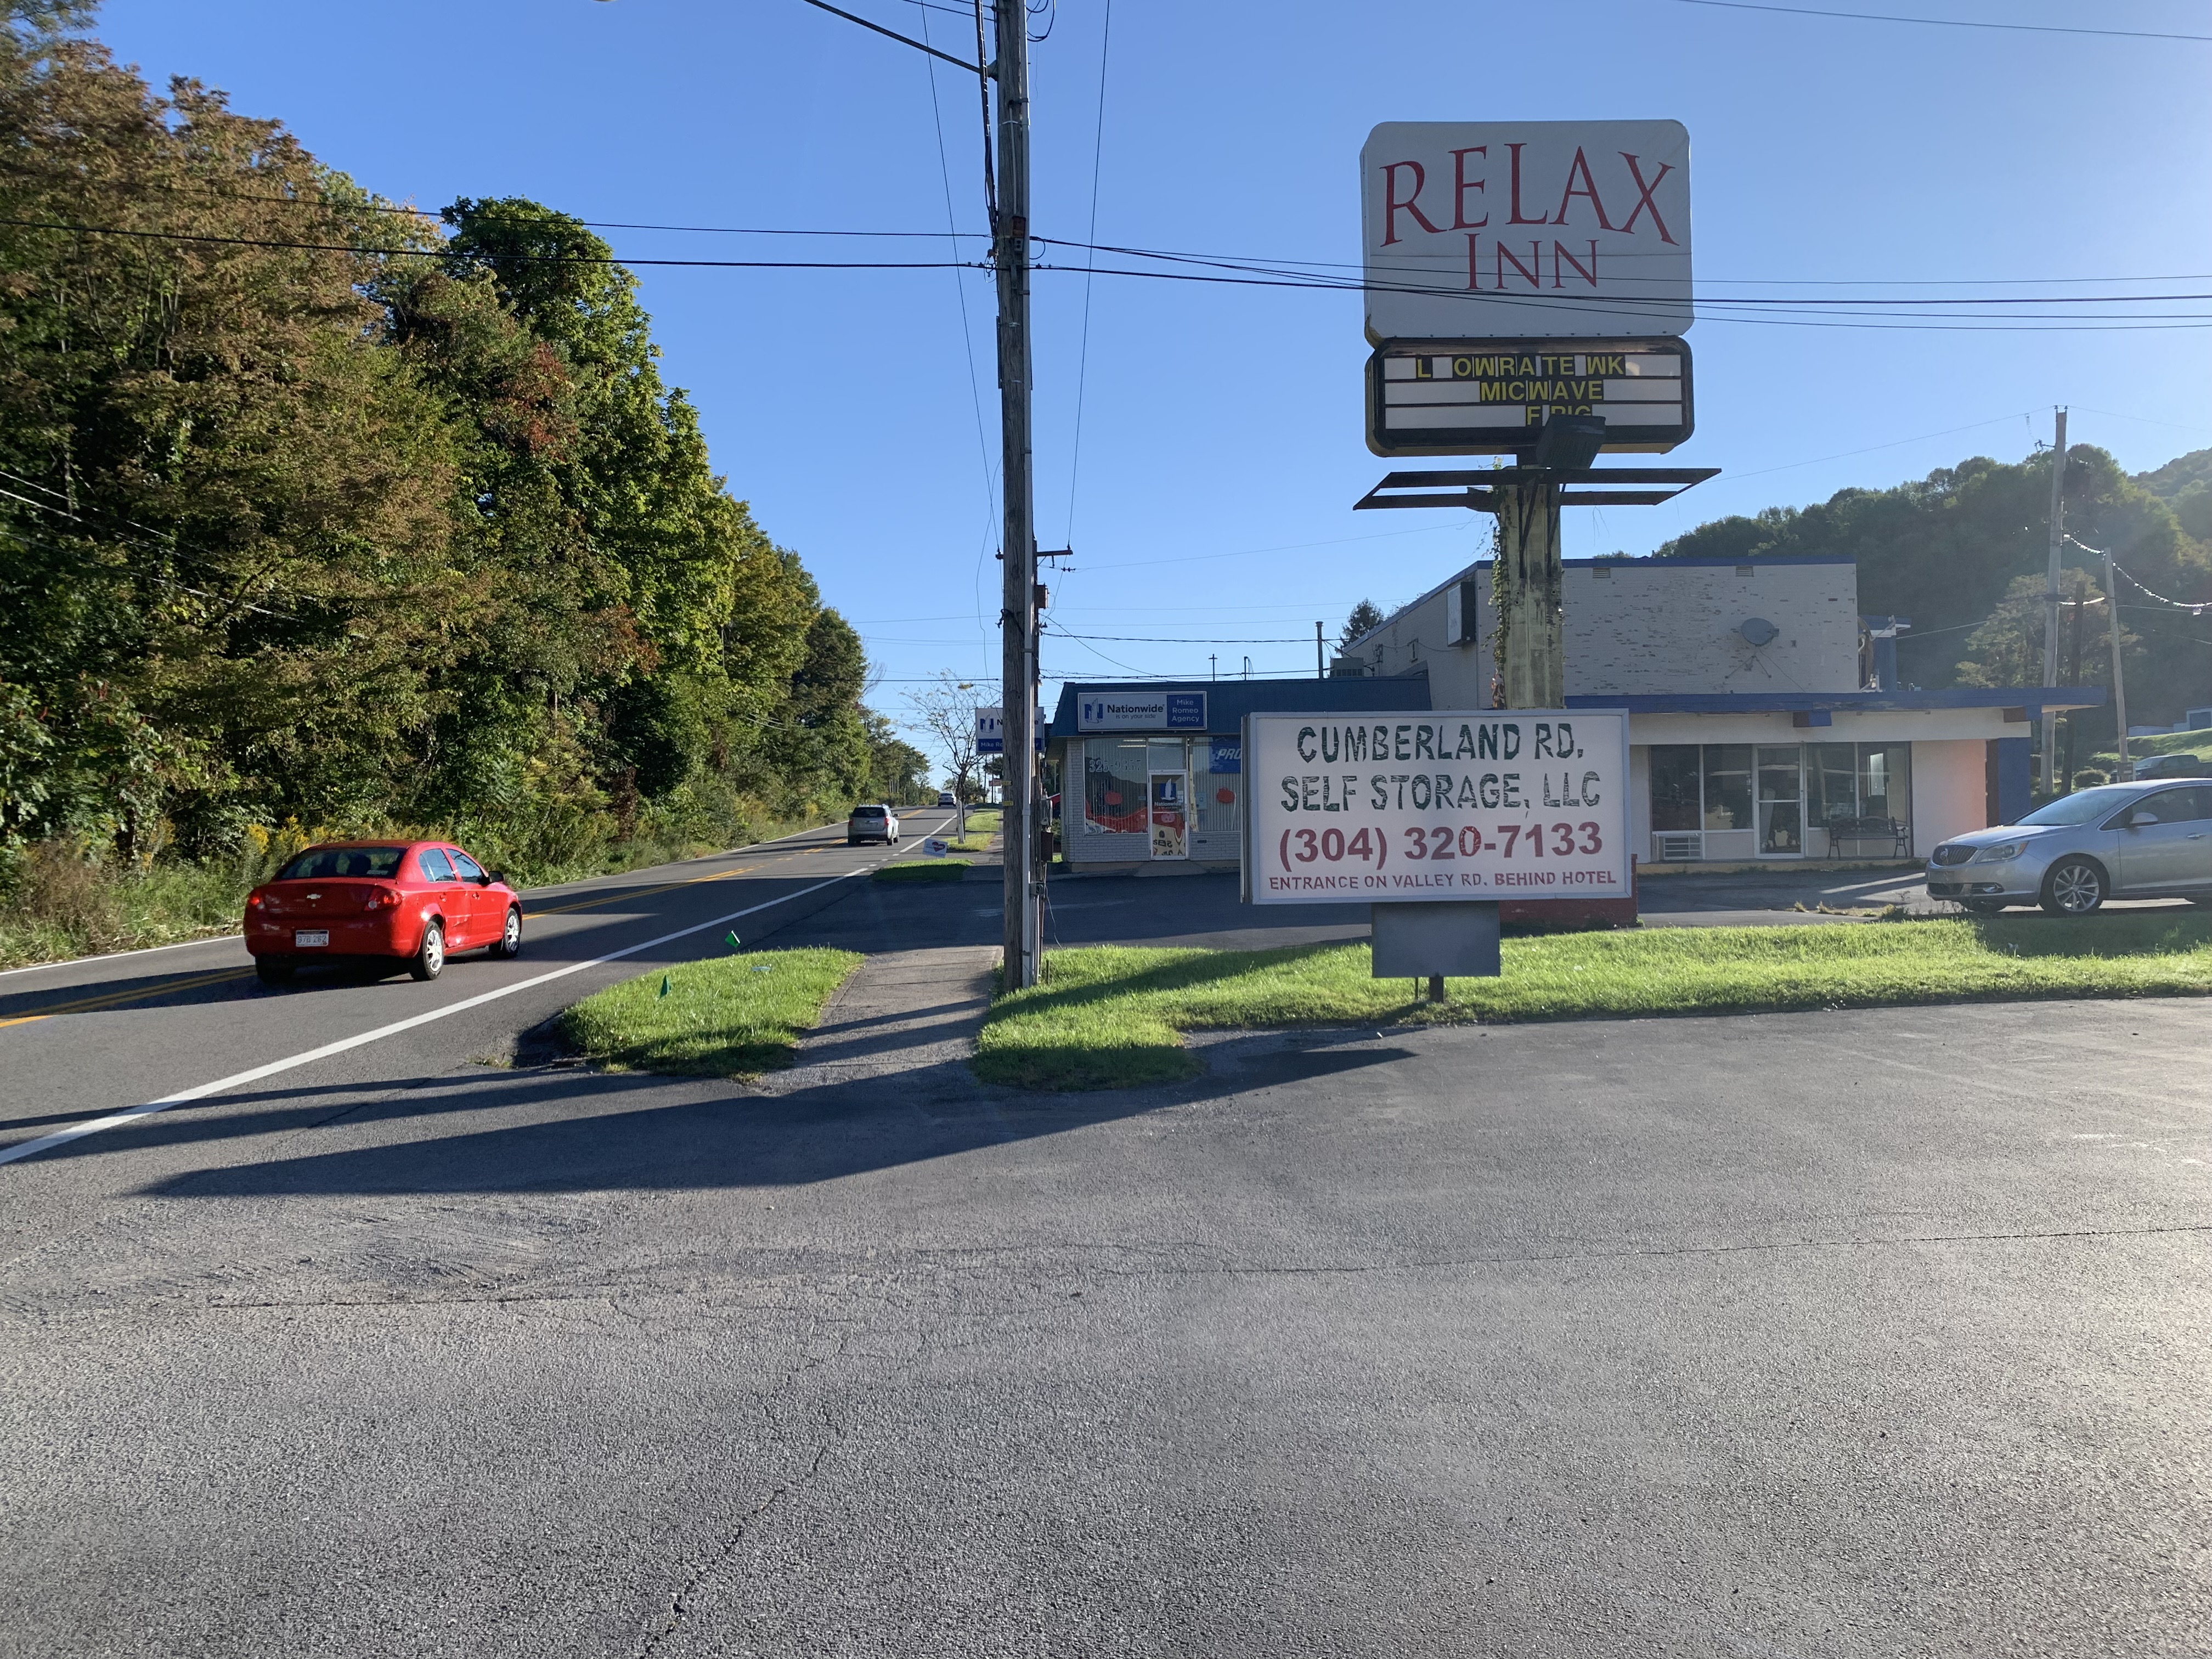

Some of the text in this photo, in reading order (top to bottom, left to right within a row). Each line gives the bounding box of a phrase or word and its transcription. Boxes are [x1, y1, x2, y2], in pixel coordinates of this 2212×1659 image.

[1379, 143, 1680, 247] RELAX
[1464, 233, 1599, 290] INN
[1481, 380, 1603, 401] MICWAVE
[1107, 704, 1163, 713] Nationwide
[1297, 723, 1583, 763] CUMBERLAND RD.
[1281, 771, 1600, 812] SELF STORAGE, LLC
[1279, 821, 1602, 872] (304) 320-7133
[1269, 871, 1616, 890] ENTRANCE ON VALLEY RD. BEHIND HOTEL
